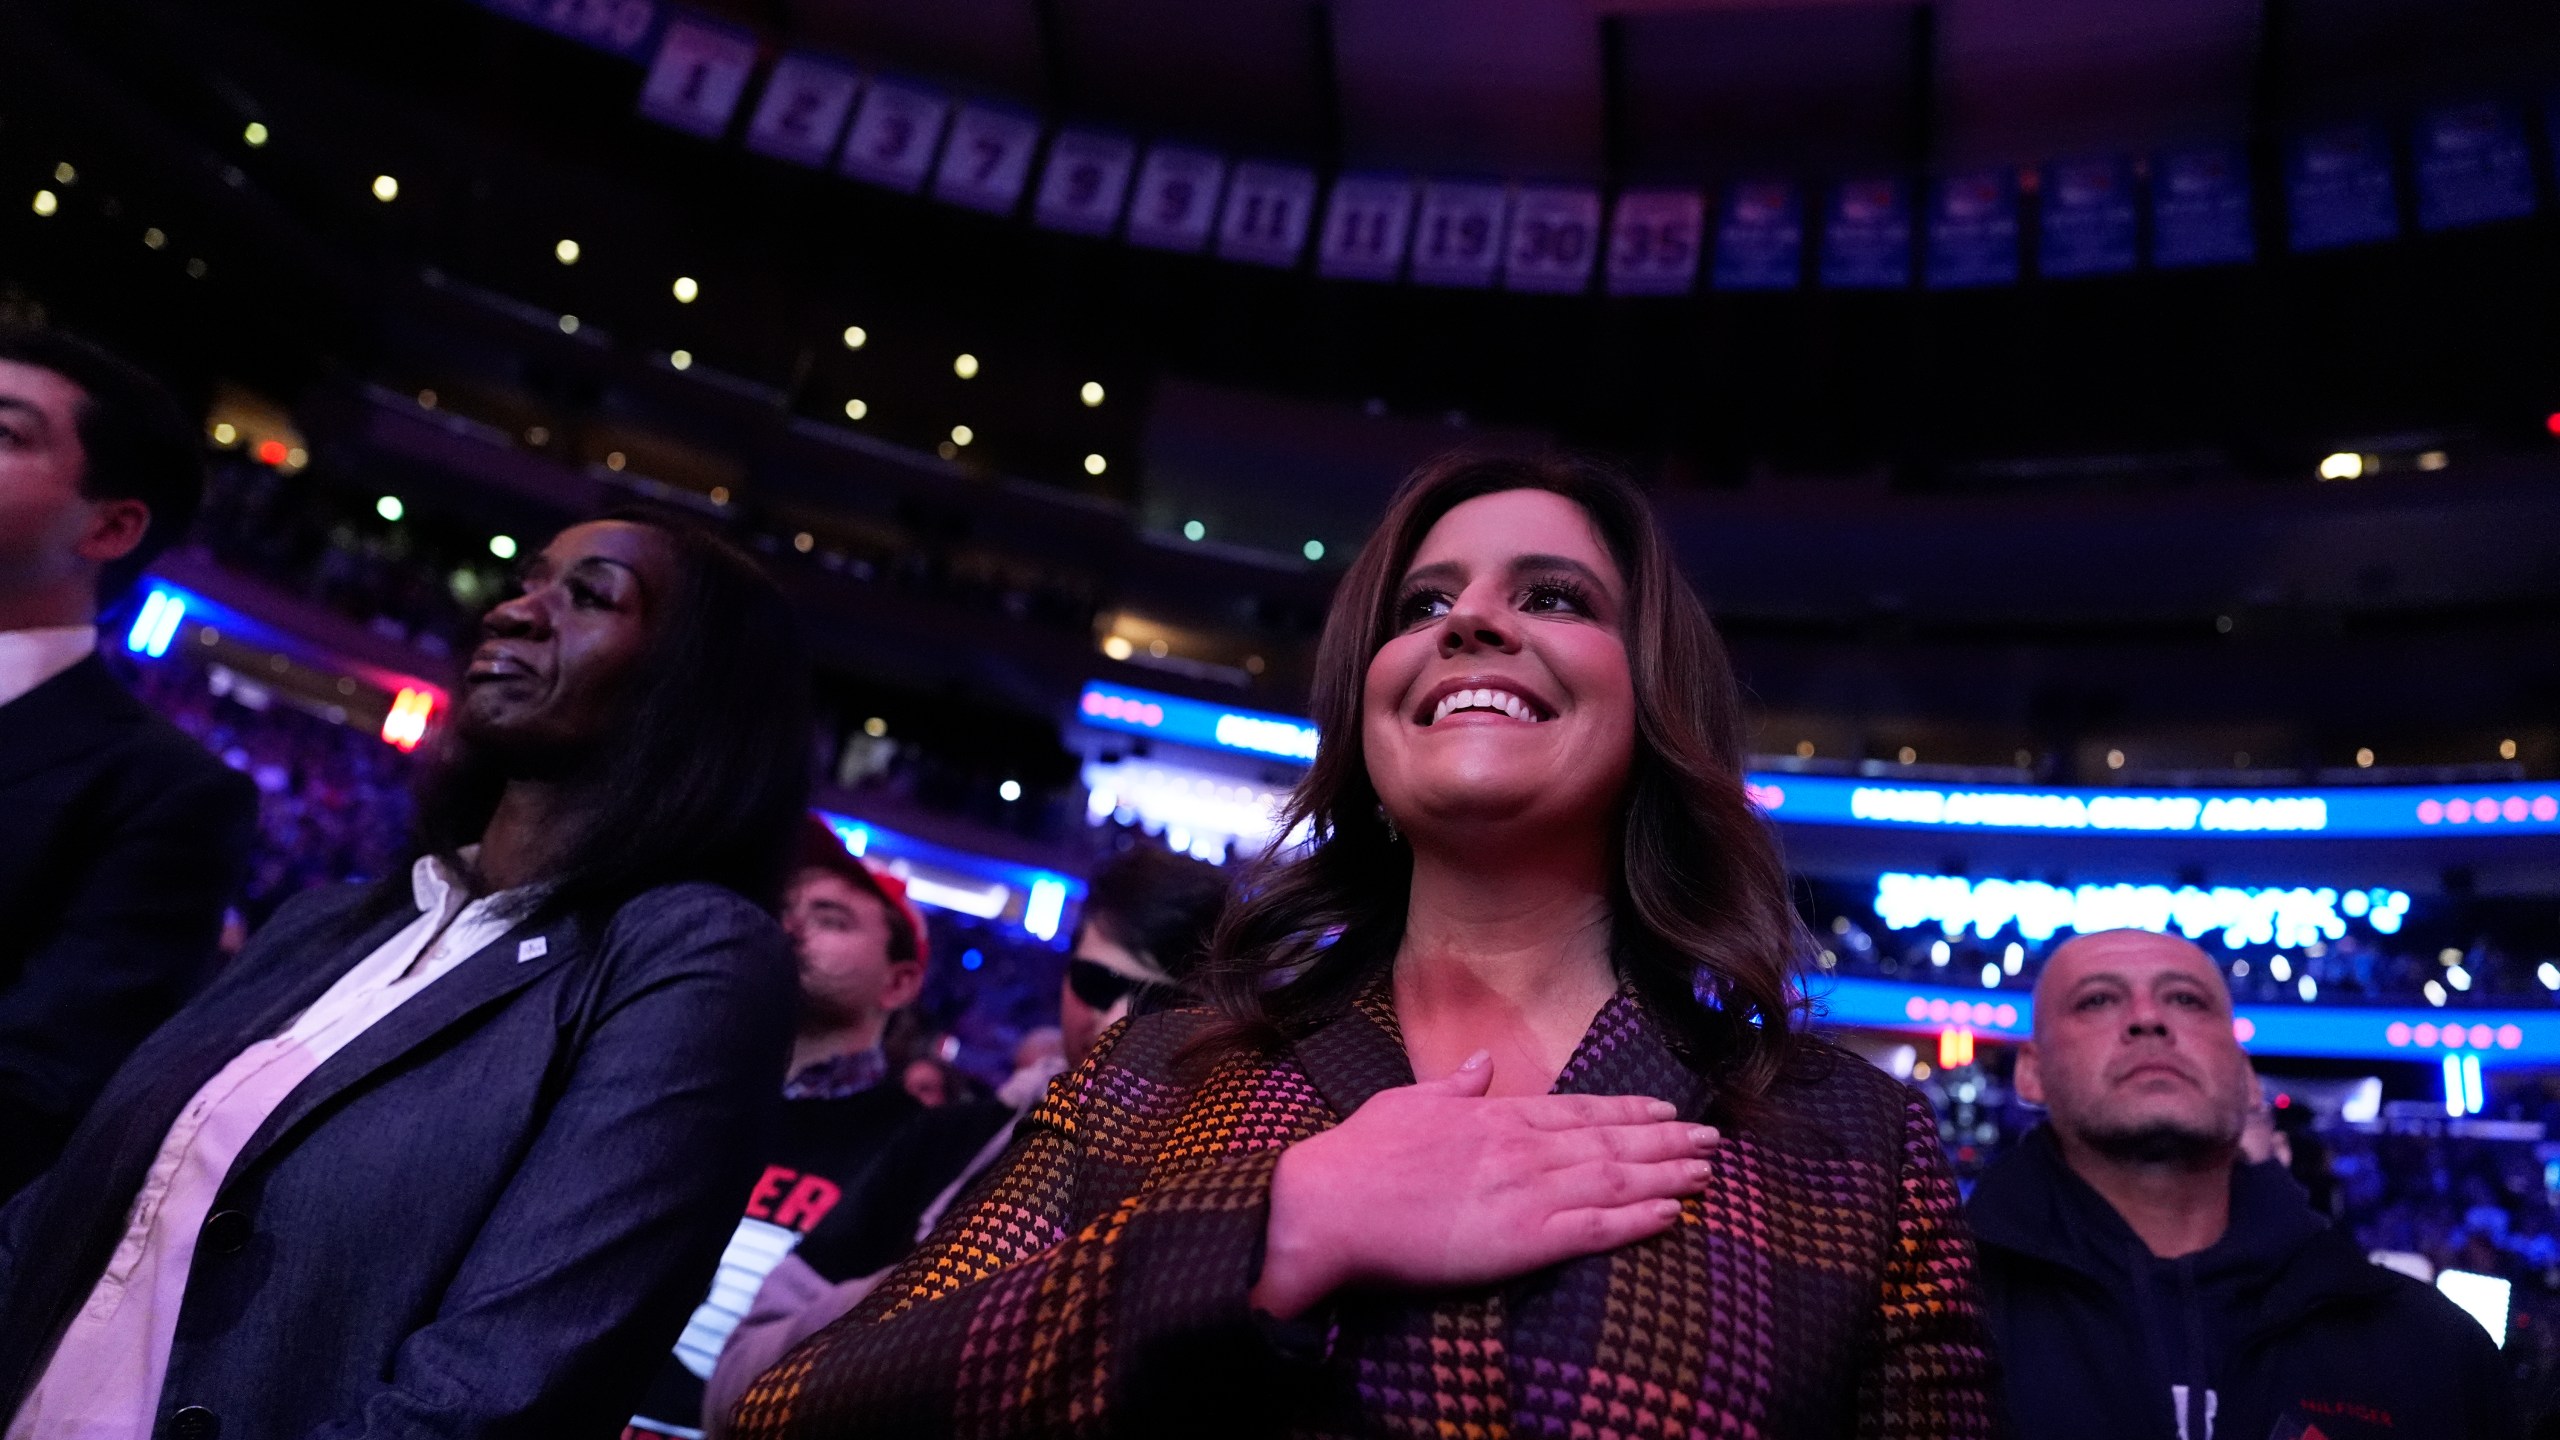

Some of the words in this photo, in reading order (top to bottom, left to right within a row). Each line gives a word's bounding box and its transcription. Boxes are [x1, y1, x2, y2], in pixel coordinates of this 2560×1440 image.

[680, 62, 712, 102] 1
[780, 89, 820, 132] 2
[875, 116, 916, 160] 3
[971, 138, 1006, 181] 7
[1246, 193, 1290, 239] 11
[1342, 210, 1387, 255] 11
[1430, 214, 1488, 258] 19
[1519, 220, 1585, 266] 30
[1620, 225, 1688, 268] 35
